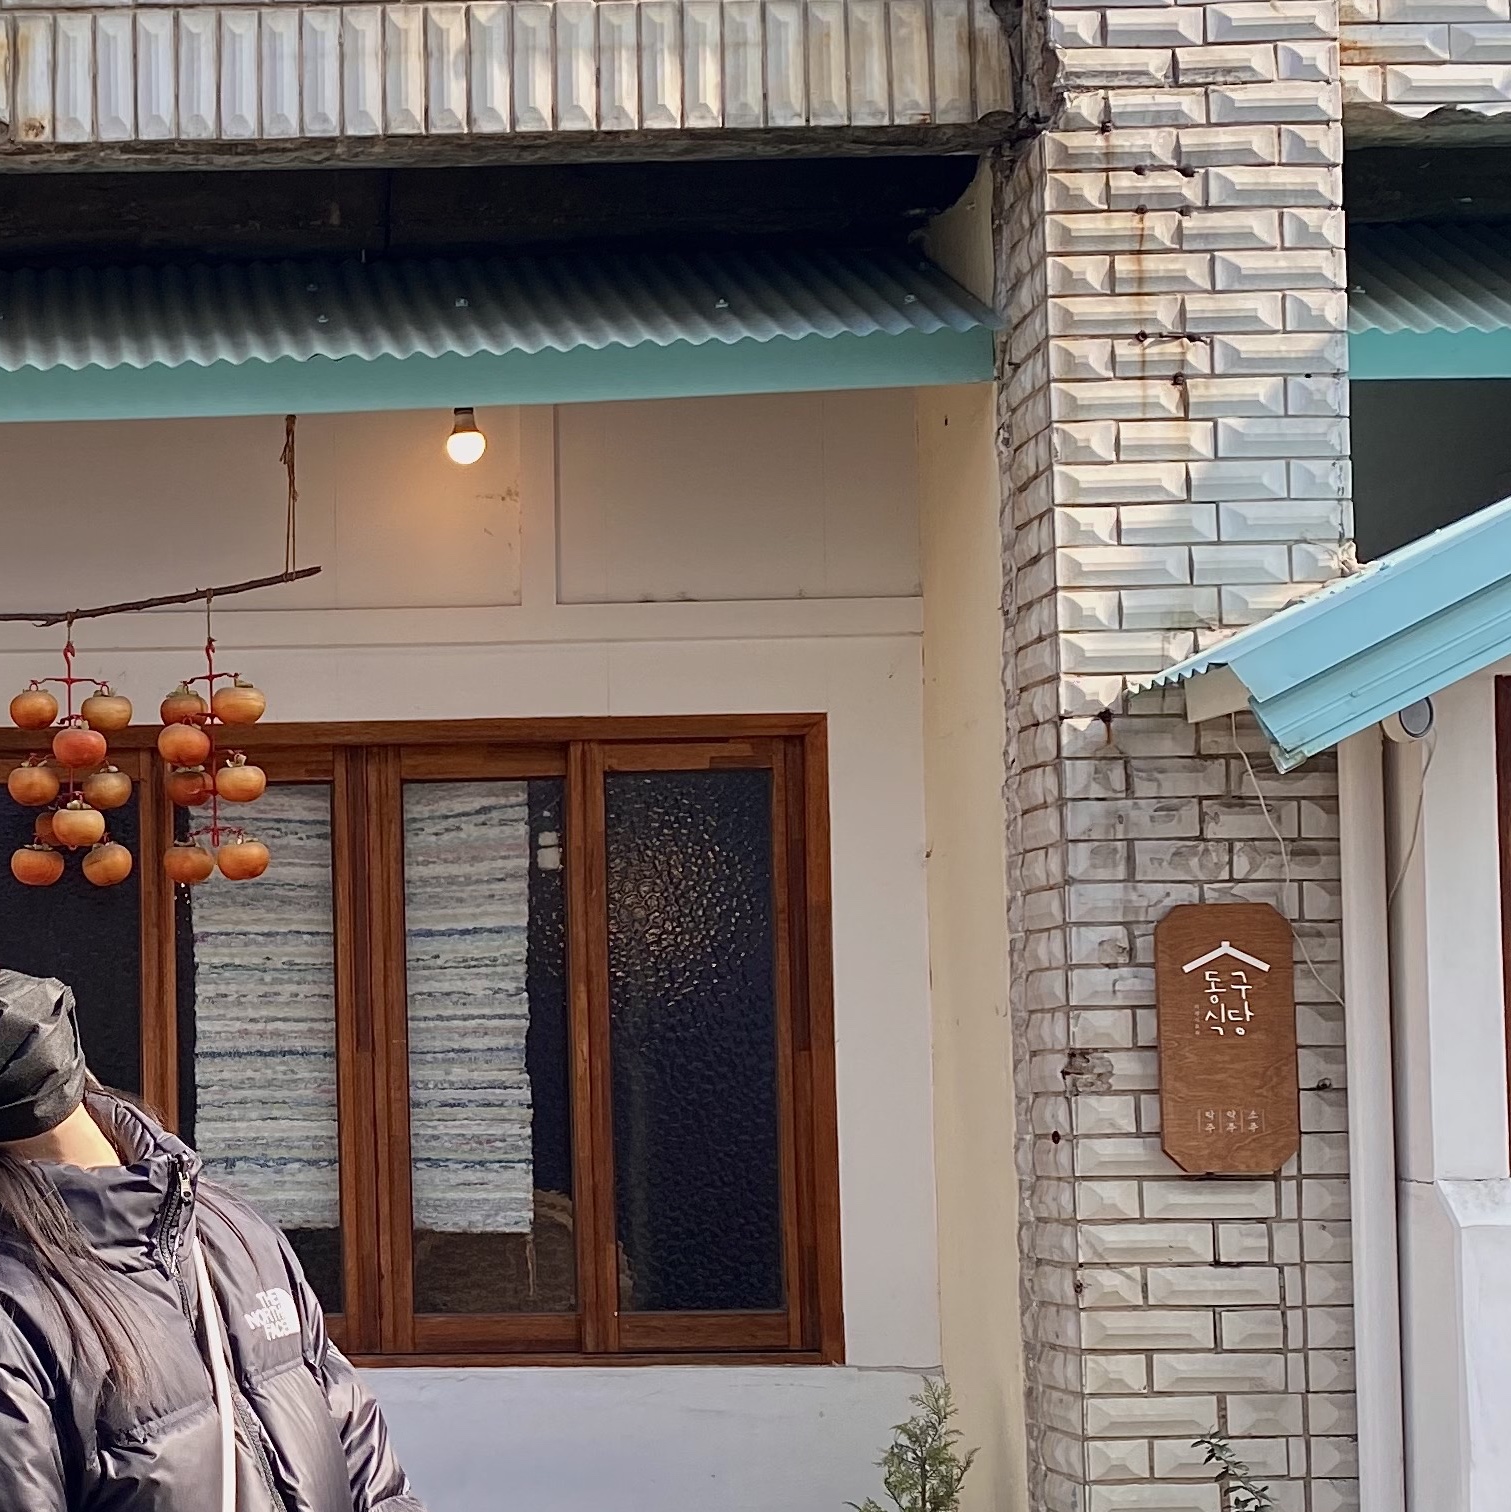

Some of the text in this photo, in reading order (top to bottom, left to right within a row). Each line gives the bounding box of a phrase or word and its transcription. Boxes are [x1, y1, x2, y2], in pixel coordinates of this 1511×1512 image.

[1204, 970, 1252, 1004] 동구
[1204, 1001, 1255, 1036] 식당
[1248, 1109, 1259, 1133] 소주
[255, 1289, 280, 1309] THE
[244, 1304, 284, 1330] NORTH
[264, 1320, 291, 1341] FACE
